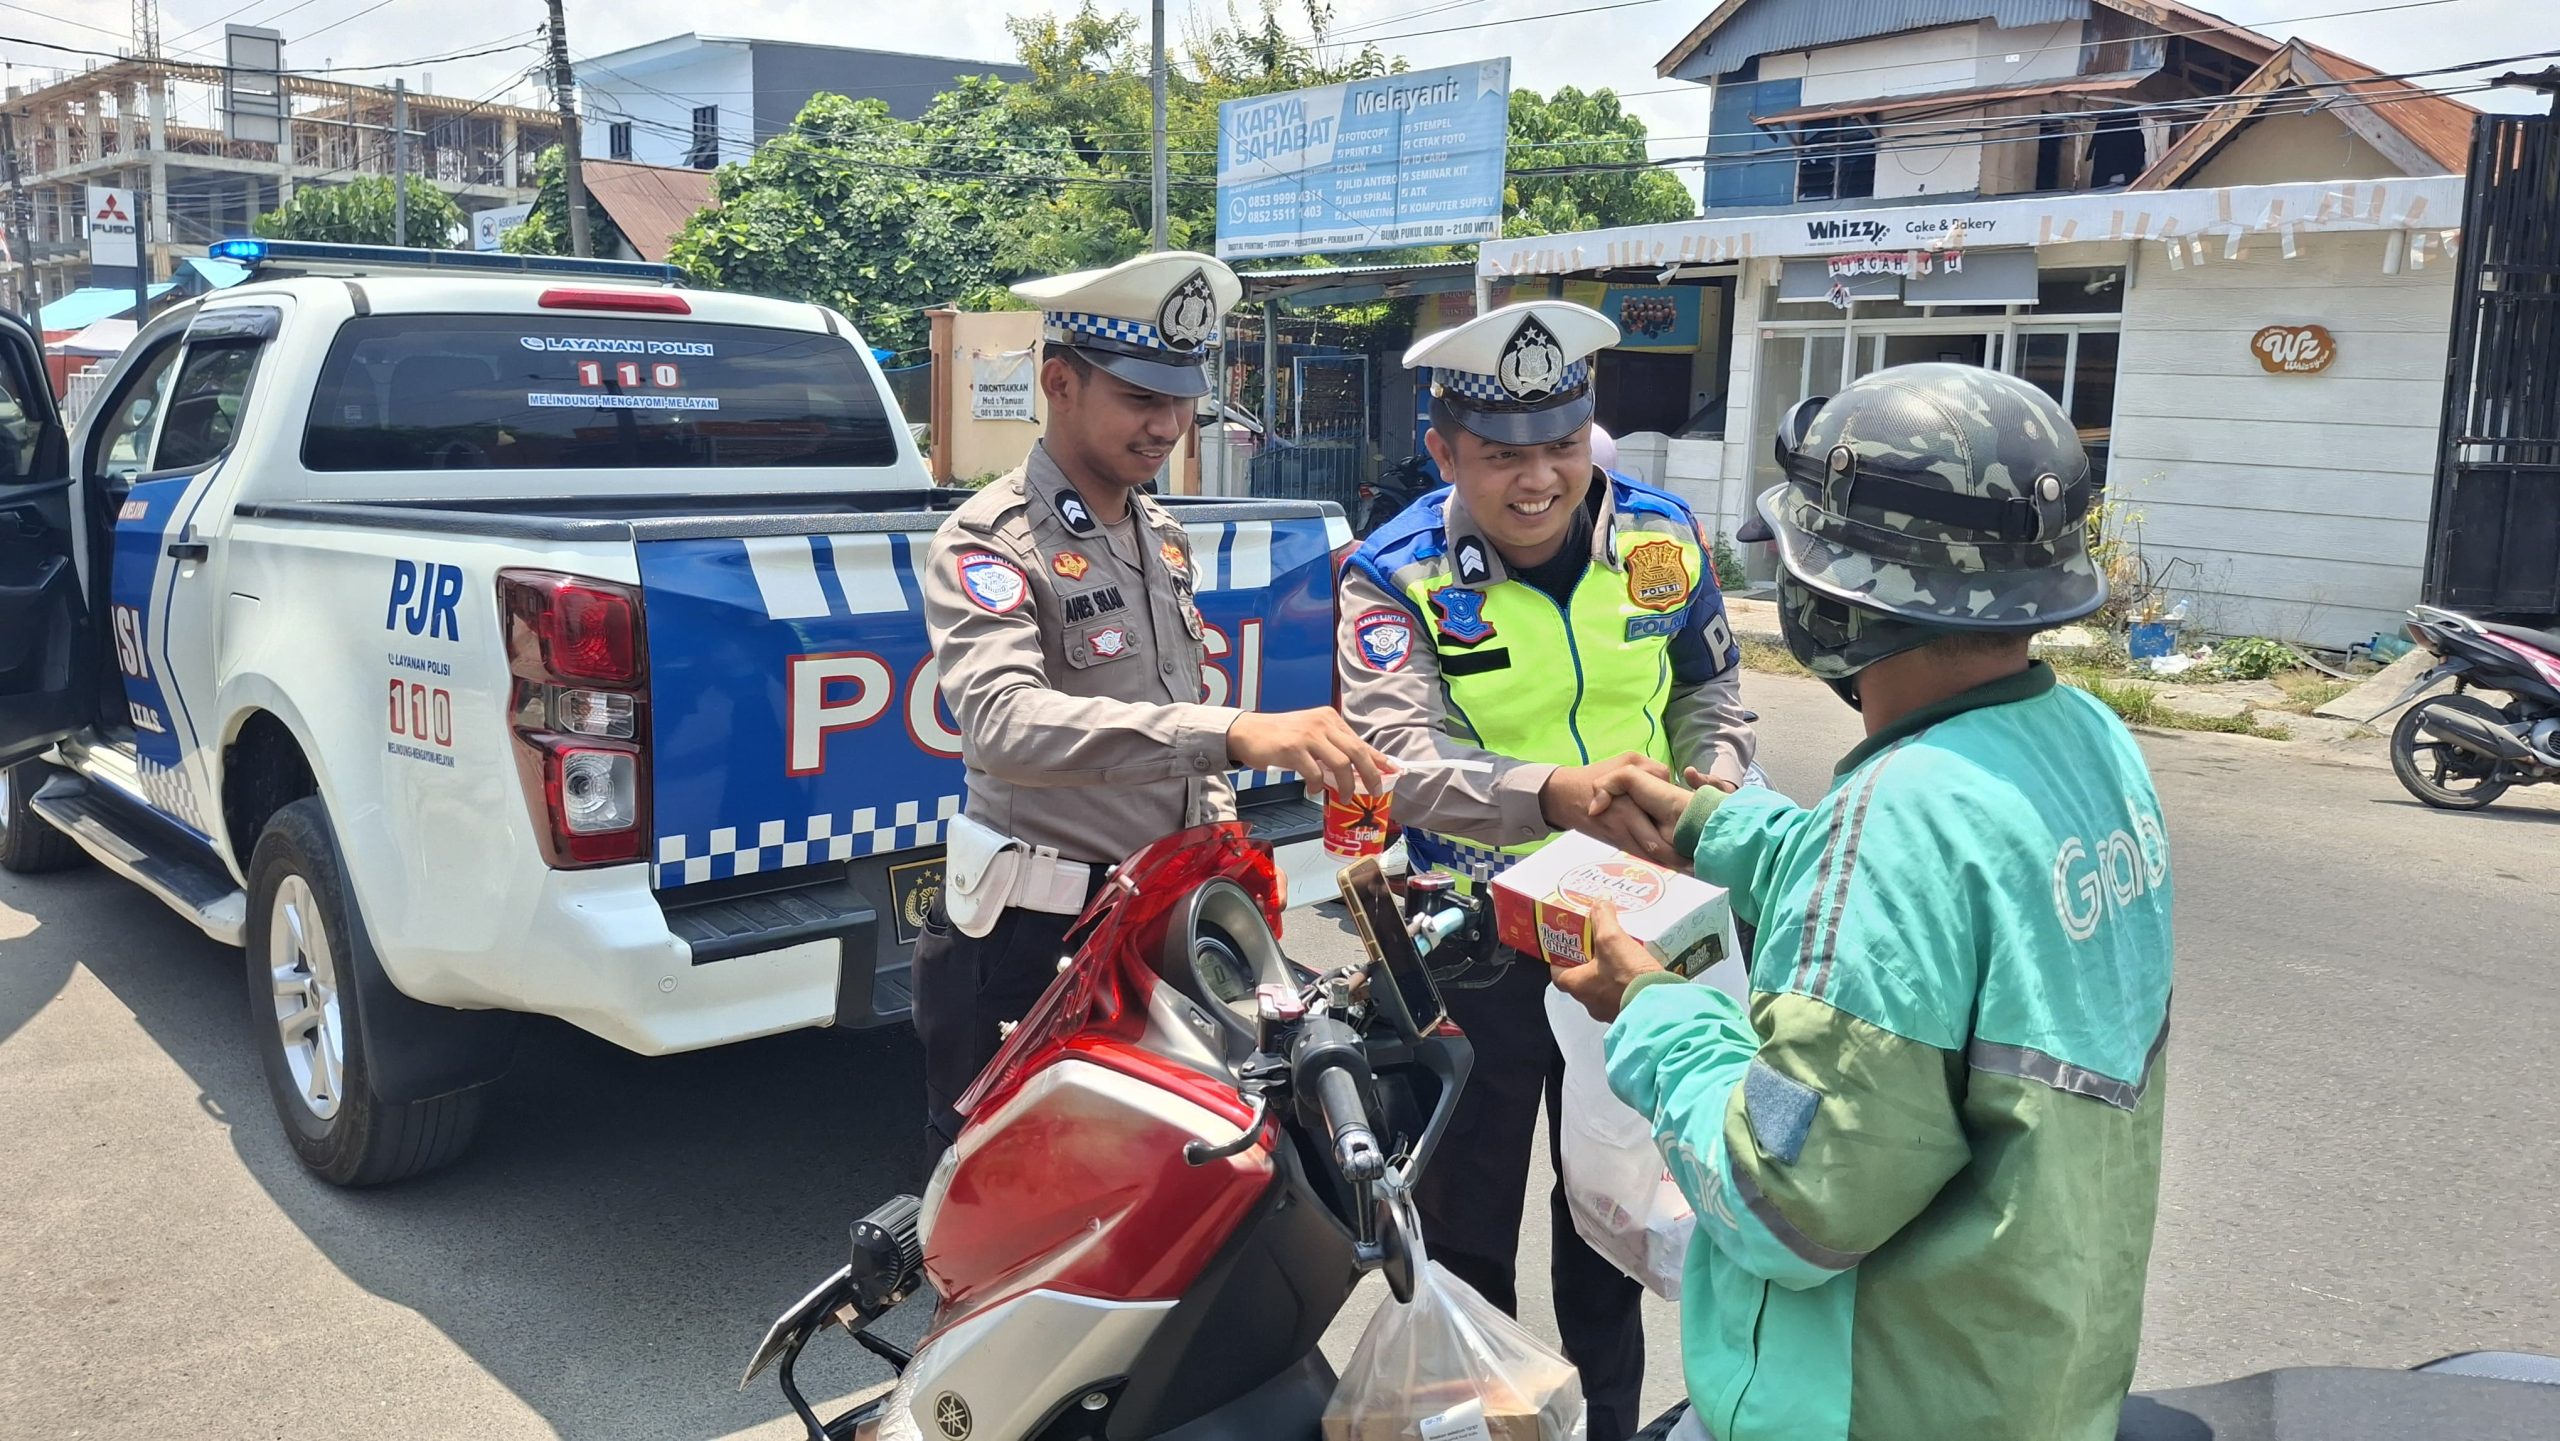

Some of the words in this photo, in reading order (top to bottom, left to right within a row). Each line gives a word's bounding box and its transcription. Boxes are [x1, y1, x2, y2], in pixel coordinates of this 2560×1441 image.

[1355, 76, 1460, 115] Melayani:
[1236, 97, 1304, 138] KARYA
[1413, 118, 1452, 132] STEMPEL
[1235, 116, 1334, 166] SAHABAT
[1345, 128, 1389, 142] FOTOCOPY
[1413, 136, 1440, 148] CETAK
[1442, 132, 1466, 144] FOTO
[1345, 147, 1370, 158] PRINT
[1371, 145, 1382, 154] A3
[1423, 151, 1448, 163] CARD
[1345, 163, 1367, 173] SCAN
[1411, 169, 1452, 181] SEMINAR
[1453, 166, 1468, 176] KIT
[1343, 179, 1362, 192] JILID
[1364, 175, 1397, 187] ANTERO
[1410, 186, 1427, 197] ATK
[1248, 193, 1271, 208] 0853
[1273, 191, 1297, 205] 9999
[1342, 194, 1361, 207] JILID
[1363, 191, 1392, 202] SPIRAL
[1410, 200, 1458, 214] KOMPUTER
[1459, 196, 1494, 209] SUPPLY
[1248, 209, 1271, 224] 0852
[1273, 207, 1296, 221] 5511
[1342, 206, 1395, 221] LAMINATING
[92, 223, 135, 235] FUSO
[1381, 229, 1400, 240] BUKA
[1401, 227, 1422, 239] PUKUL
[1453, 223, 1473, 235] 21.00
[1474, 221, 1494, 233] WITA
[1807, 219, 1887, 244] Whizzy
[1905, 220, 1936, 233] Cake
[1939, 218, 1949, 231] &
[547, 337, 644, 353] LAYANAN
[648, 341, 715, 356] POLISI
[1641, 583, 1678, 597] POLISI
[386, 559, 463, 642] PJR
[395, 653, 426, 671] LAYANAN
[427, 660, 451, 676] POLISI
[1541, 924, 1579, 948] Rocket
[1545, 938, 1588, 963] Chicken
